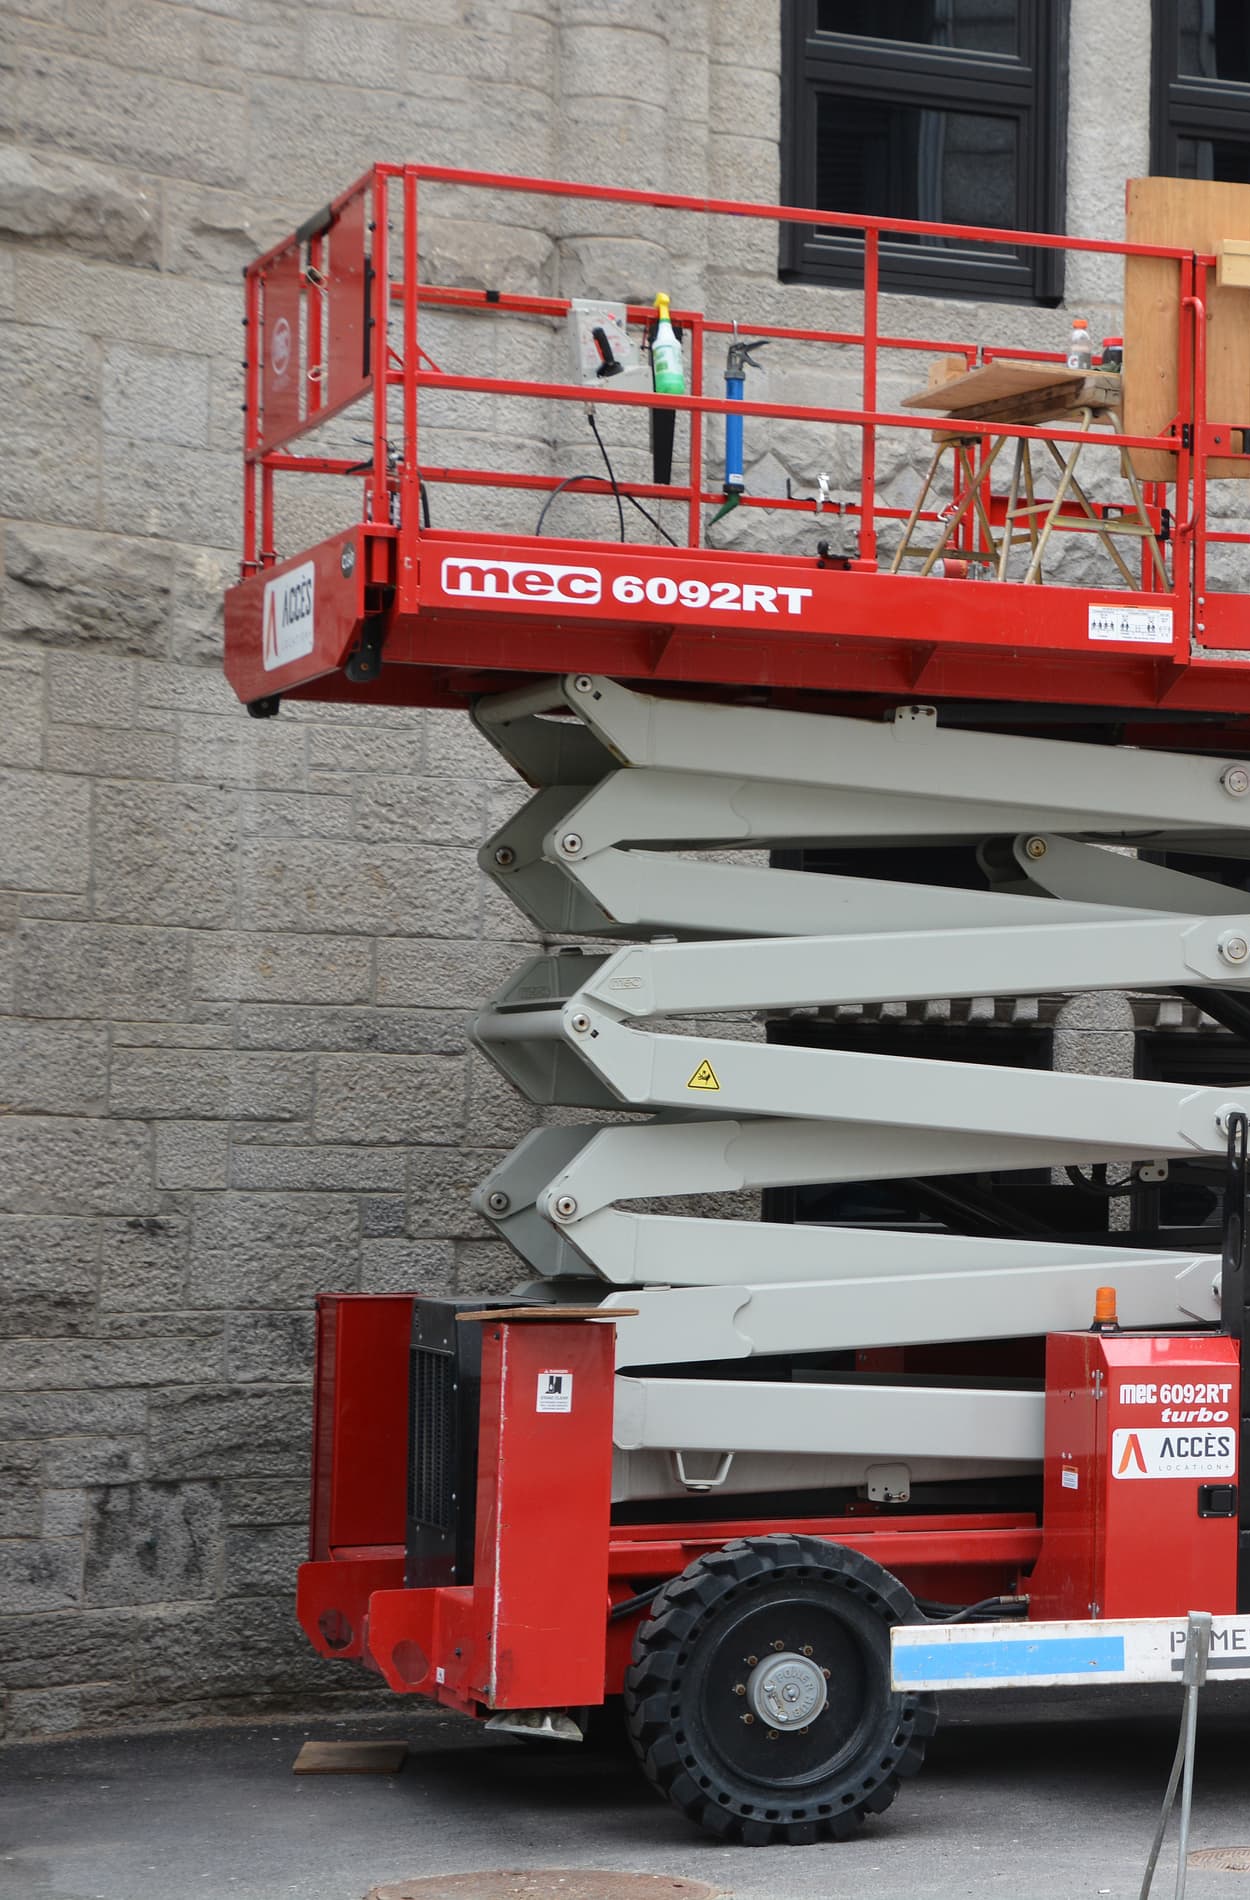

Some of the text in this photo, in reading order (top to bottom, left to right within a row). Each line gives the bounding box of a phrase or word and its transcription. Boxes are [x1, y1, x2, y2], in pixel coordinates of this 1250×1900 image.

[282, 575, 312, 628] ACCÈS
[446, 563, 813, 615] mec 6092RT
[1120, 1383, 1233, 1405] mec 6092RT
[1160, 1407, 1230, 1423] turbo
[1159, 1432, 1230, 1458] ACCÈS
